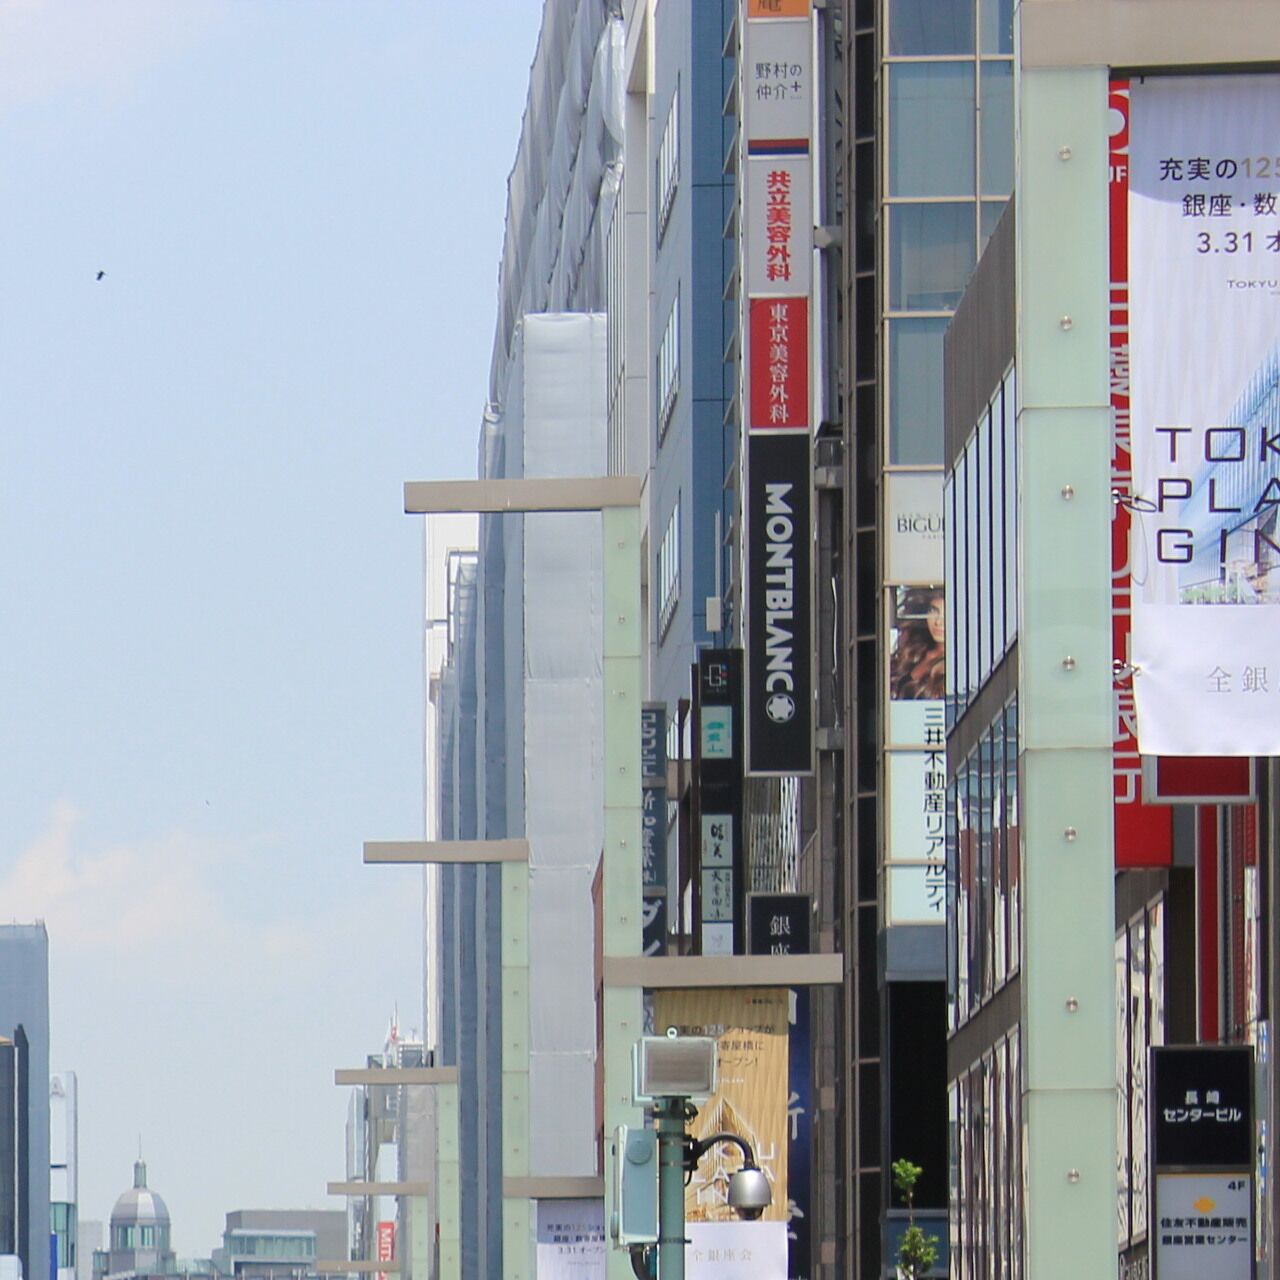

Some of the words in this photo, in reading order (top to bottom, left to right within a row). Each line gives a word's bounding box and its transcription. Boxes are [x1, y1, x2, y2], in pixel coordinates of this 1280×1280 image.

[755, 62, 802, 80] 野村の
[1182, 193, 1277, 218] 銀座・数
[766, 170, 792, 281] 共立美容外科
[1196, 232, 1255, 255] 3.31
[1226, 279, 1278, 289] TOKYU
[768, 304, 790, 424] 東京美容外科
[765, 483, 793, 694] MONTBLANC
[924, 706, 945, 913] 三井不動産リアルティ
[1163, 1107, 1242, 1123] センタービル
[1227, 1180, 1246, 1191] 4F
[1160, 1216, 1248, 1229] 住友不動産販売
